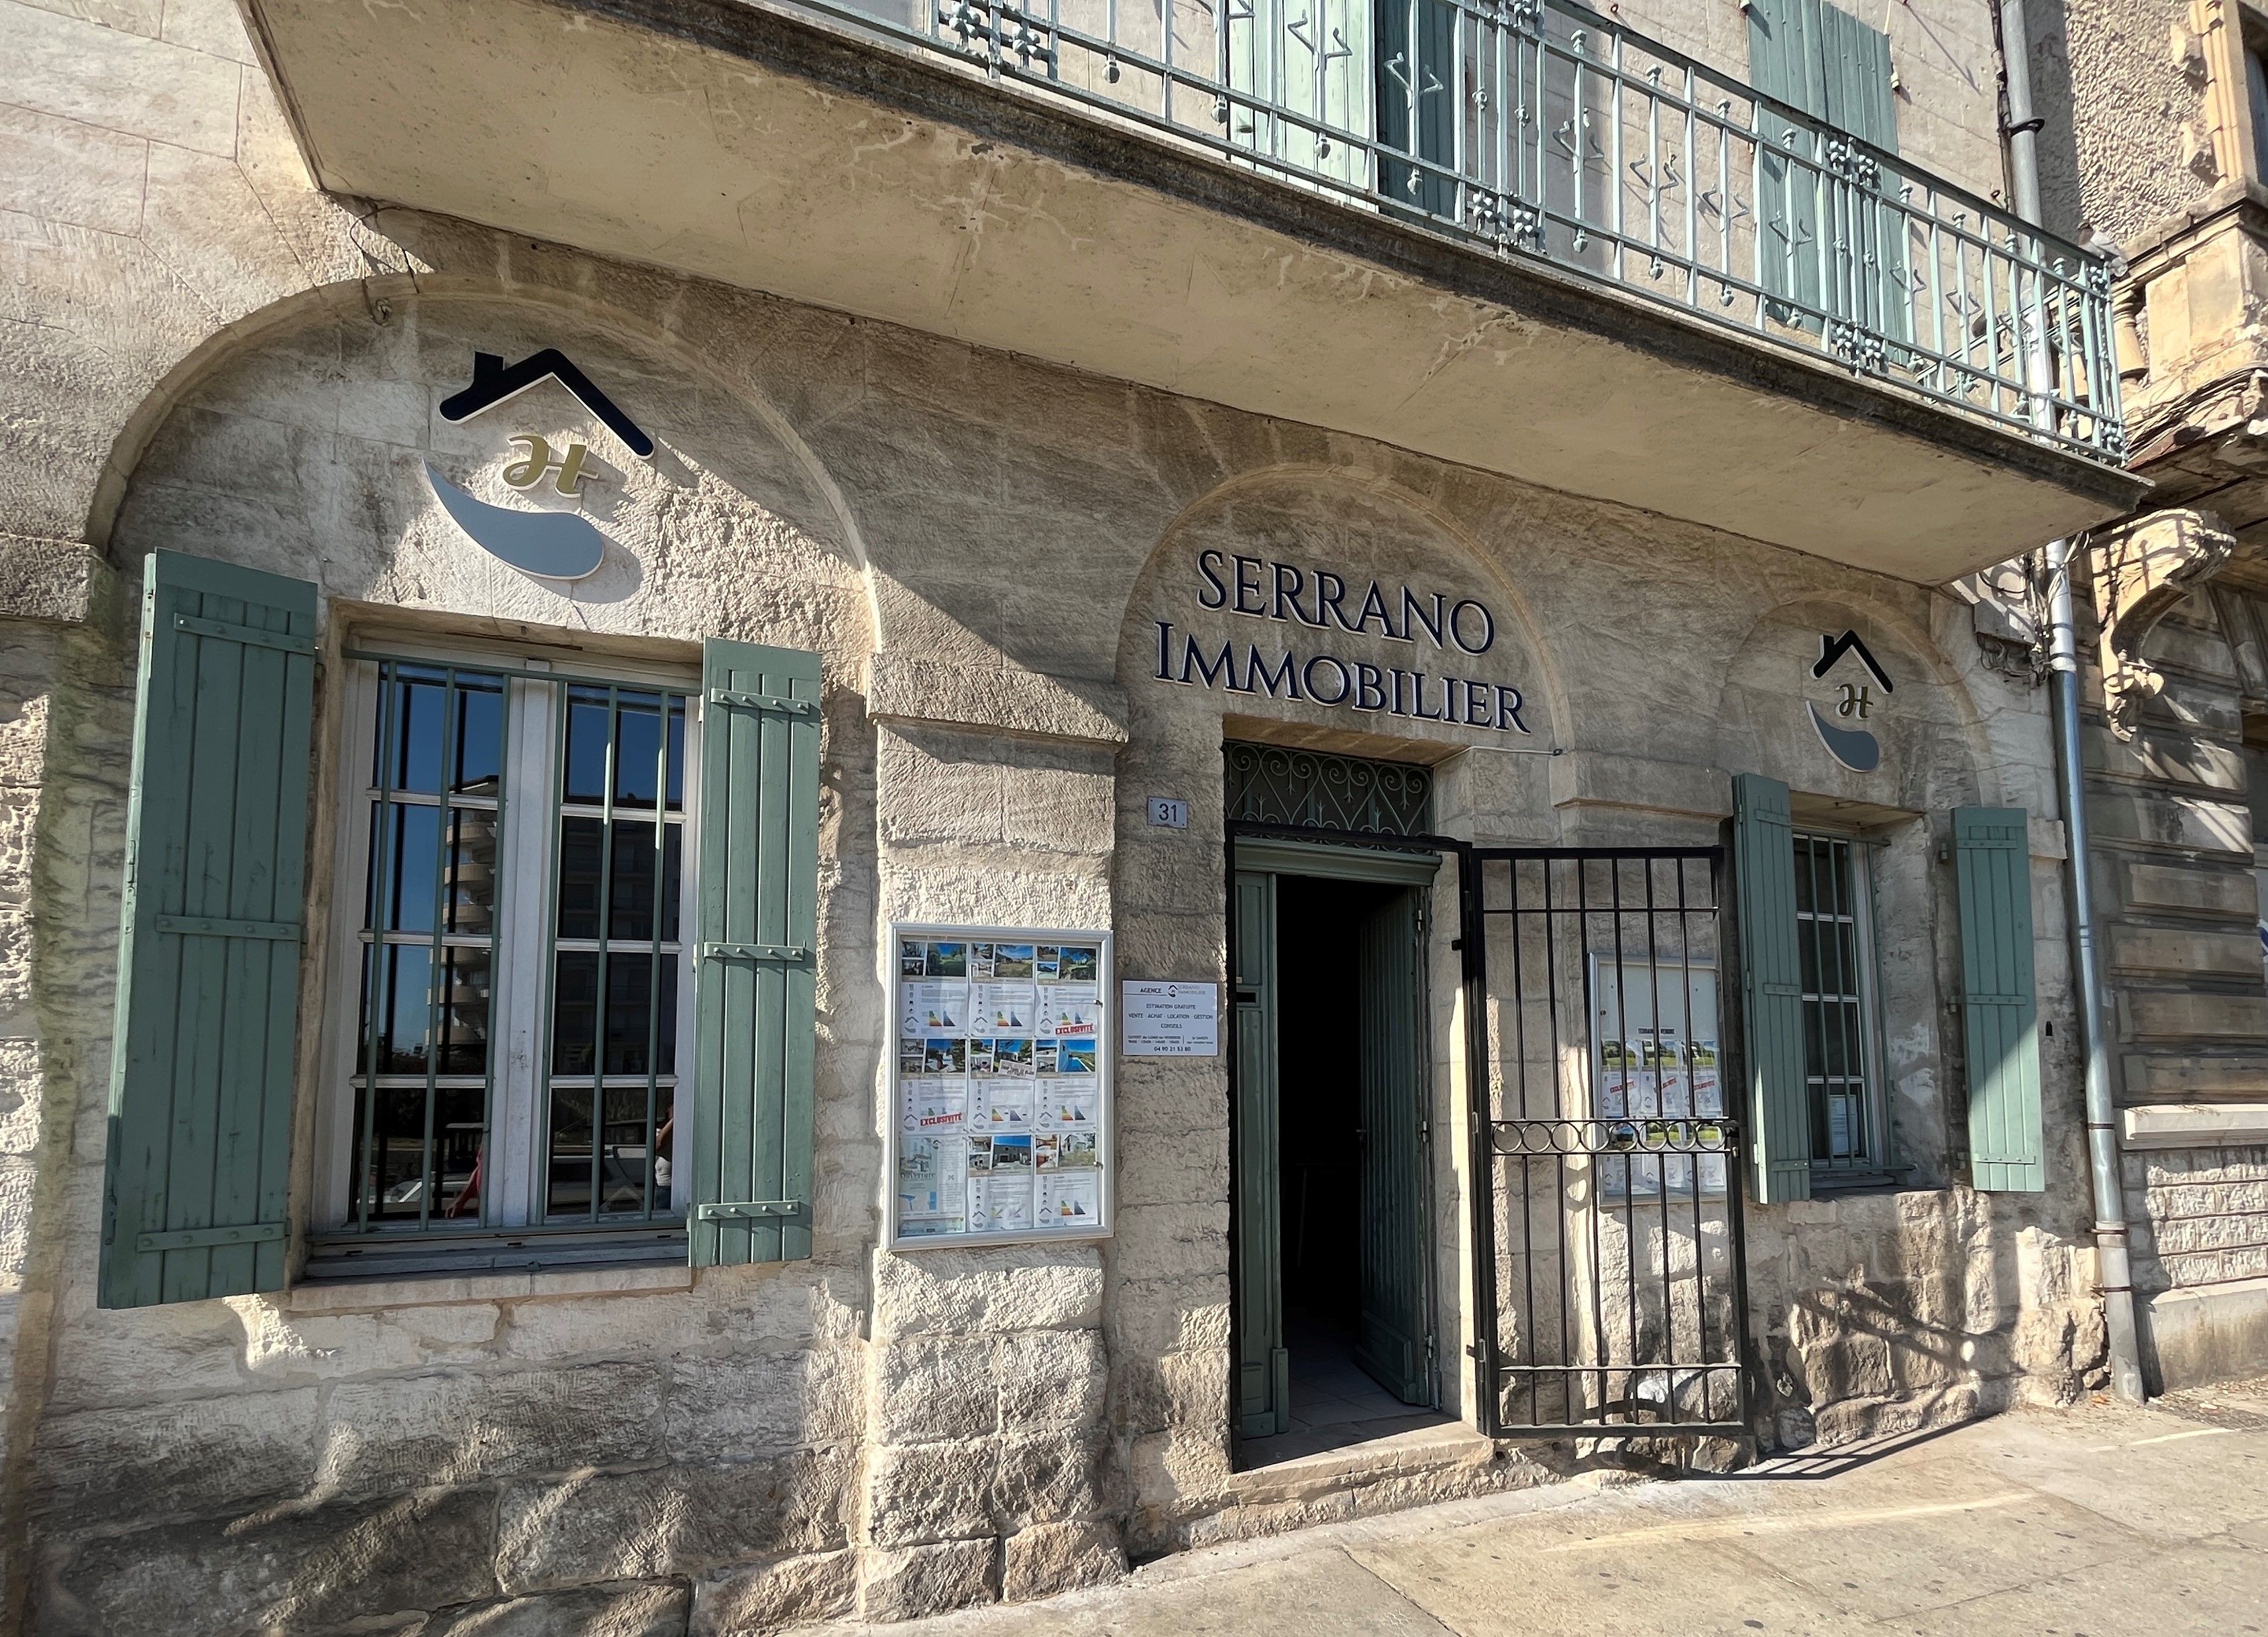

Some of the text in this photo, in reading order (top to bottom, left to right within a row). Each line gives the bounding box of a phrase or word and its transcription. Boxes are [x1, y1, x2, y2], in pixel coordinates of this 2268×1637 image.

[1197, 549, 1495, 656] SERRANO
[1154, 621, 1531, 734] IMMOBILIER
[1159, 803, 1177, 822] 31
[920, 1111, 962, 1126] EXCLUSIVITÉ
